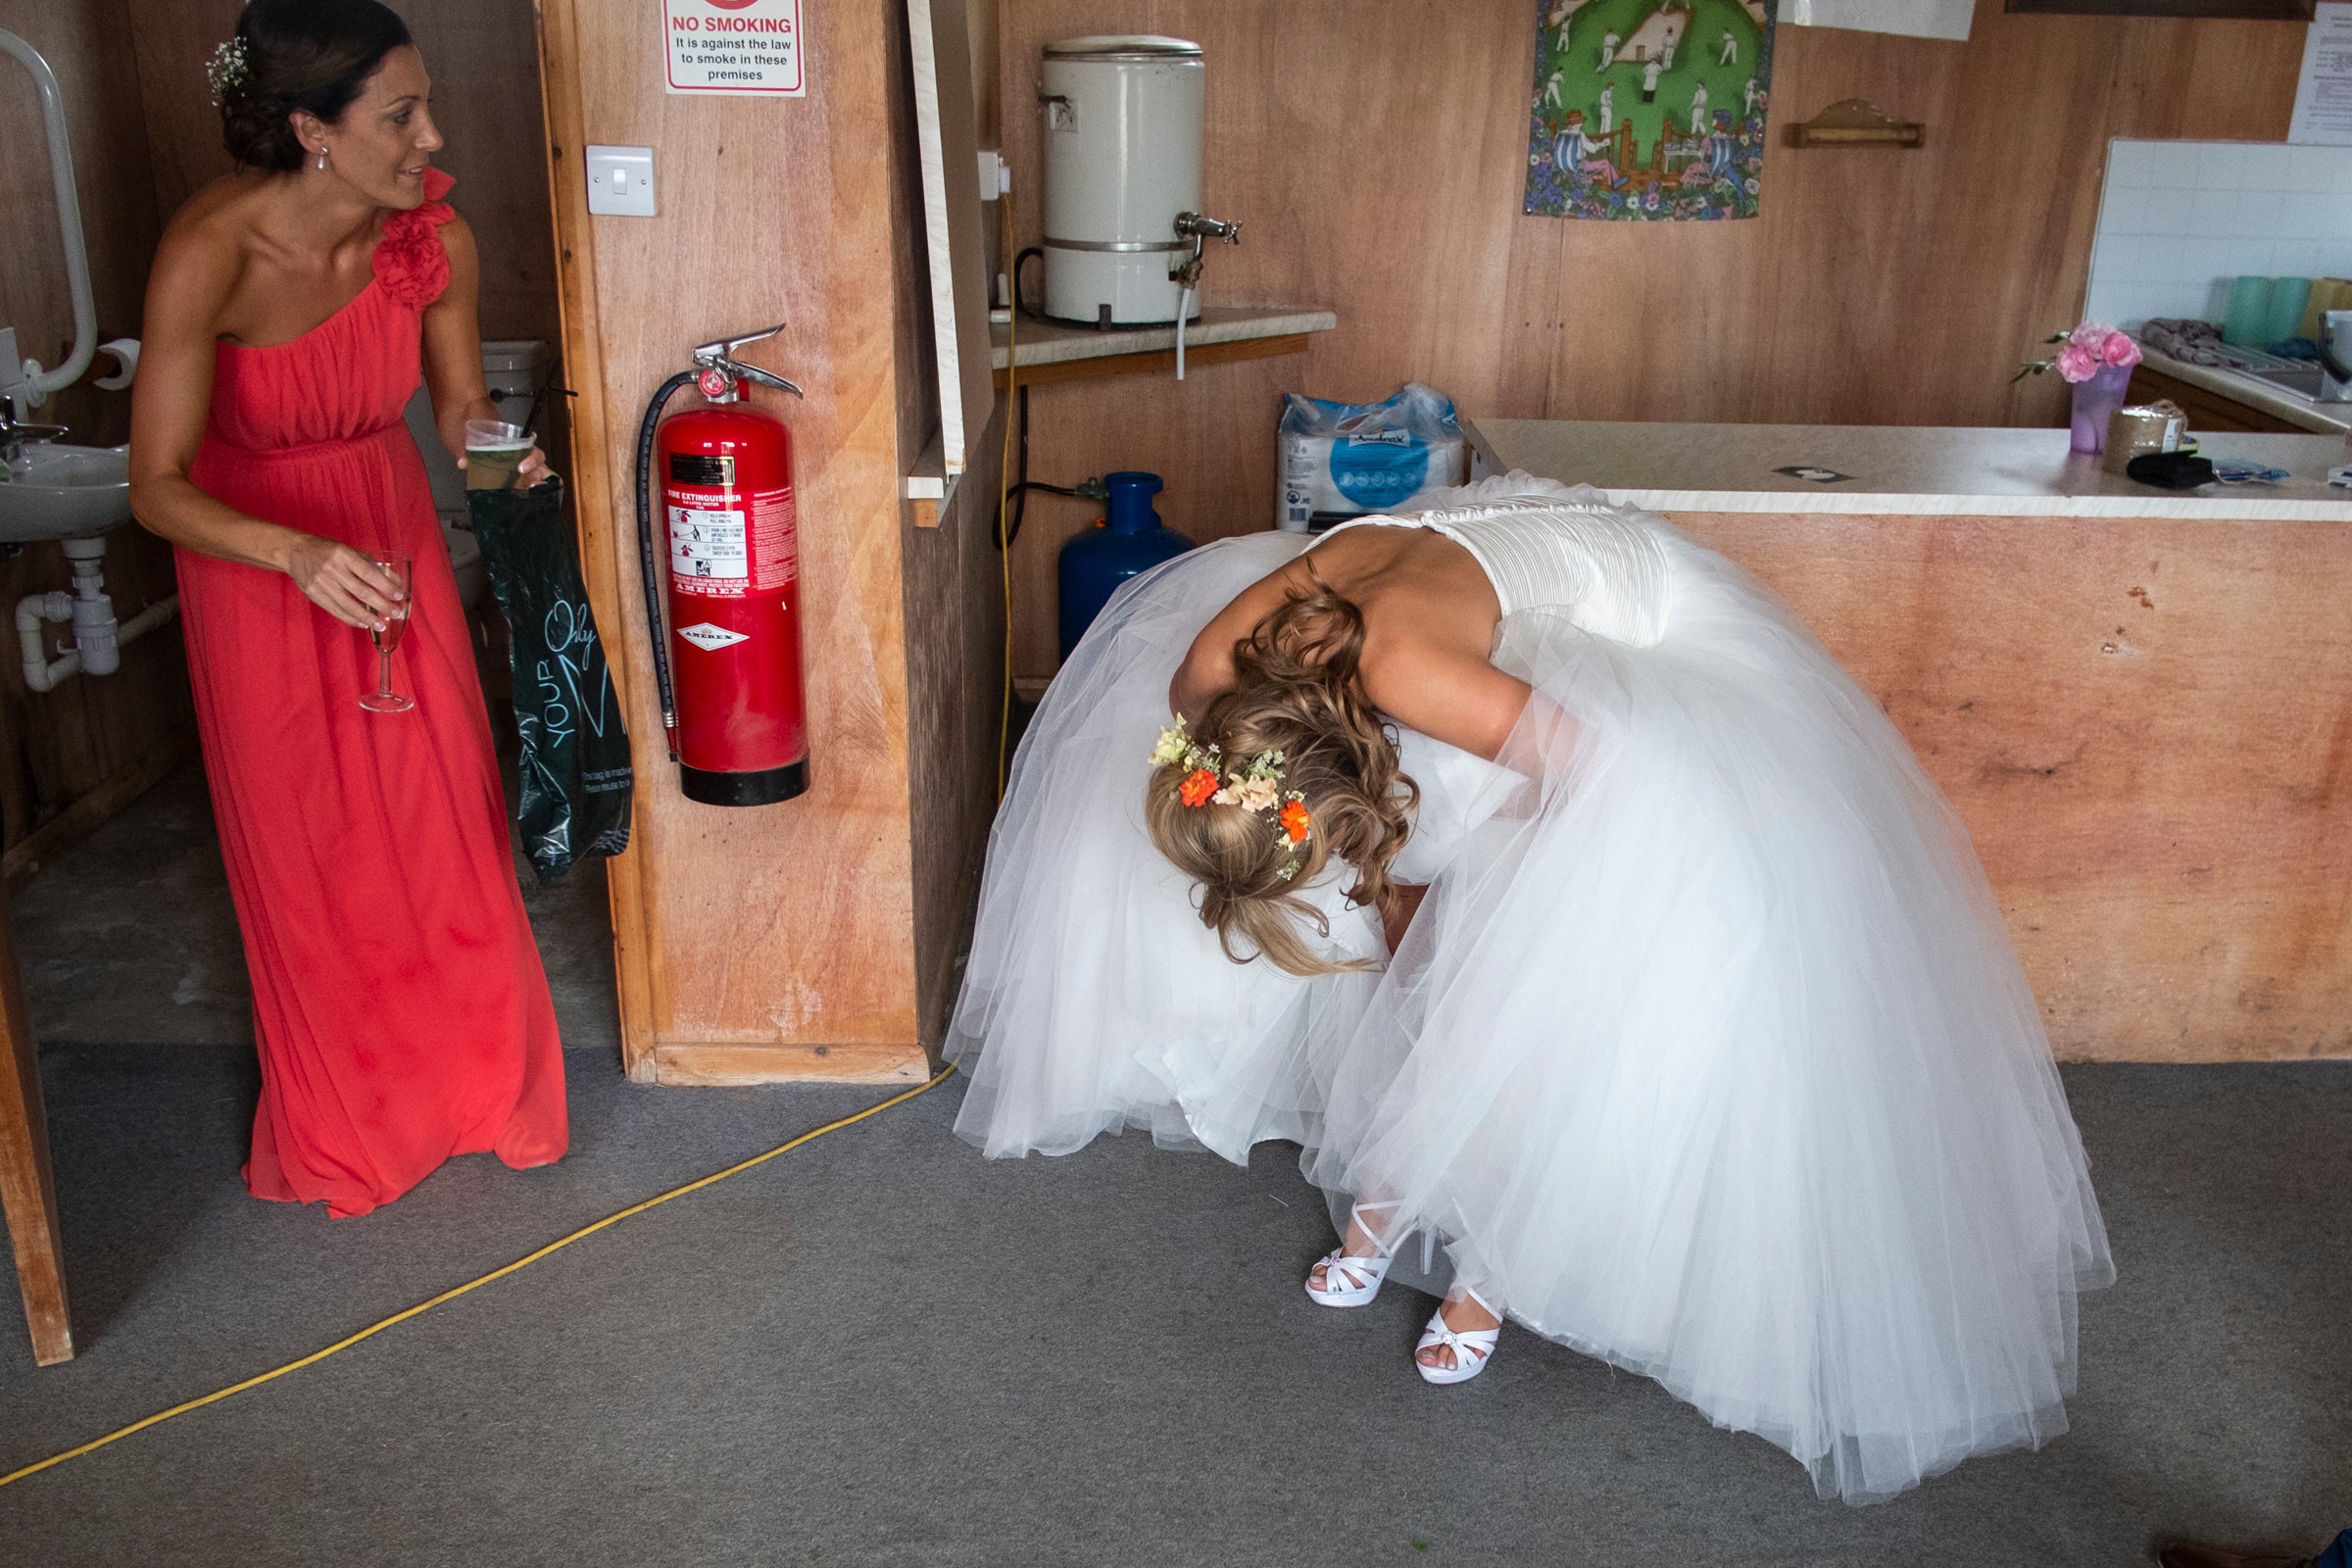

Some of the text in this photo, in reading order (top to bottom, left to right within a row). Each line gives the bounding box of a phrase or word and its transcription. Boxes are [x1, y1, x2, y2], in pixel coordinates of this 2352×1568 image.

[673, 17, 792, 33] NO SMOKING
[676, 37, 791, 51] It is against the law
[681, 54, 788, 66] to smoke in these
[708, 70, 762, 81] premises
[668, 490, 680, 499] FIRE
[681, 492, 742, 503] EXTINGUISHER
[675, 583, 745, 595] AMEREX
[685, 631, 733, 640] AMEREX
[537, 659, 575, 749] YOUR
